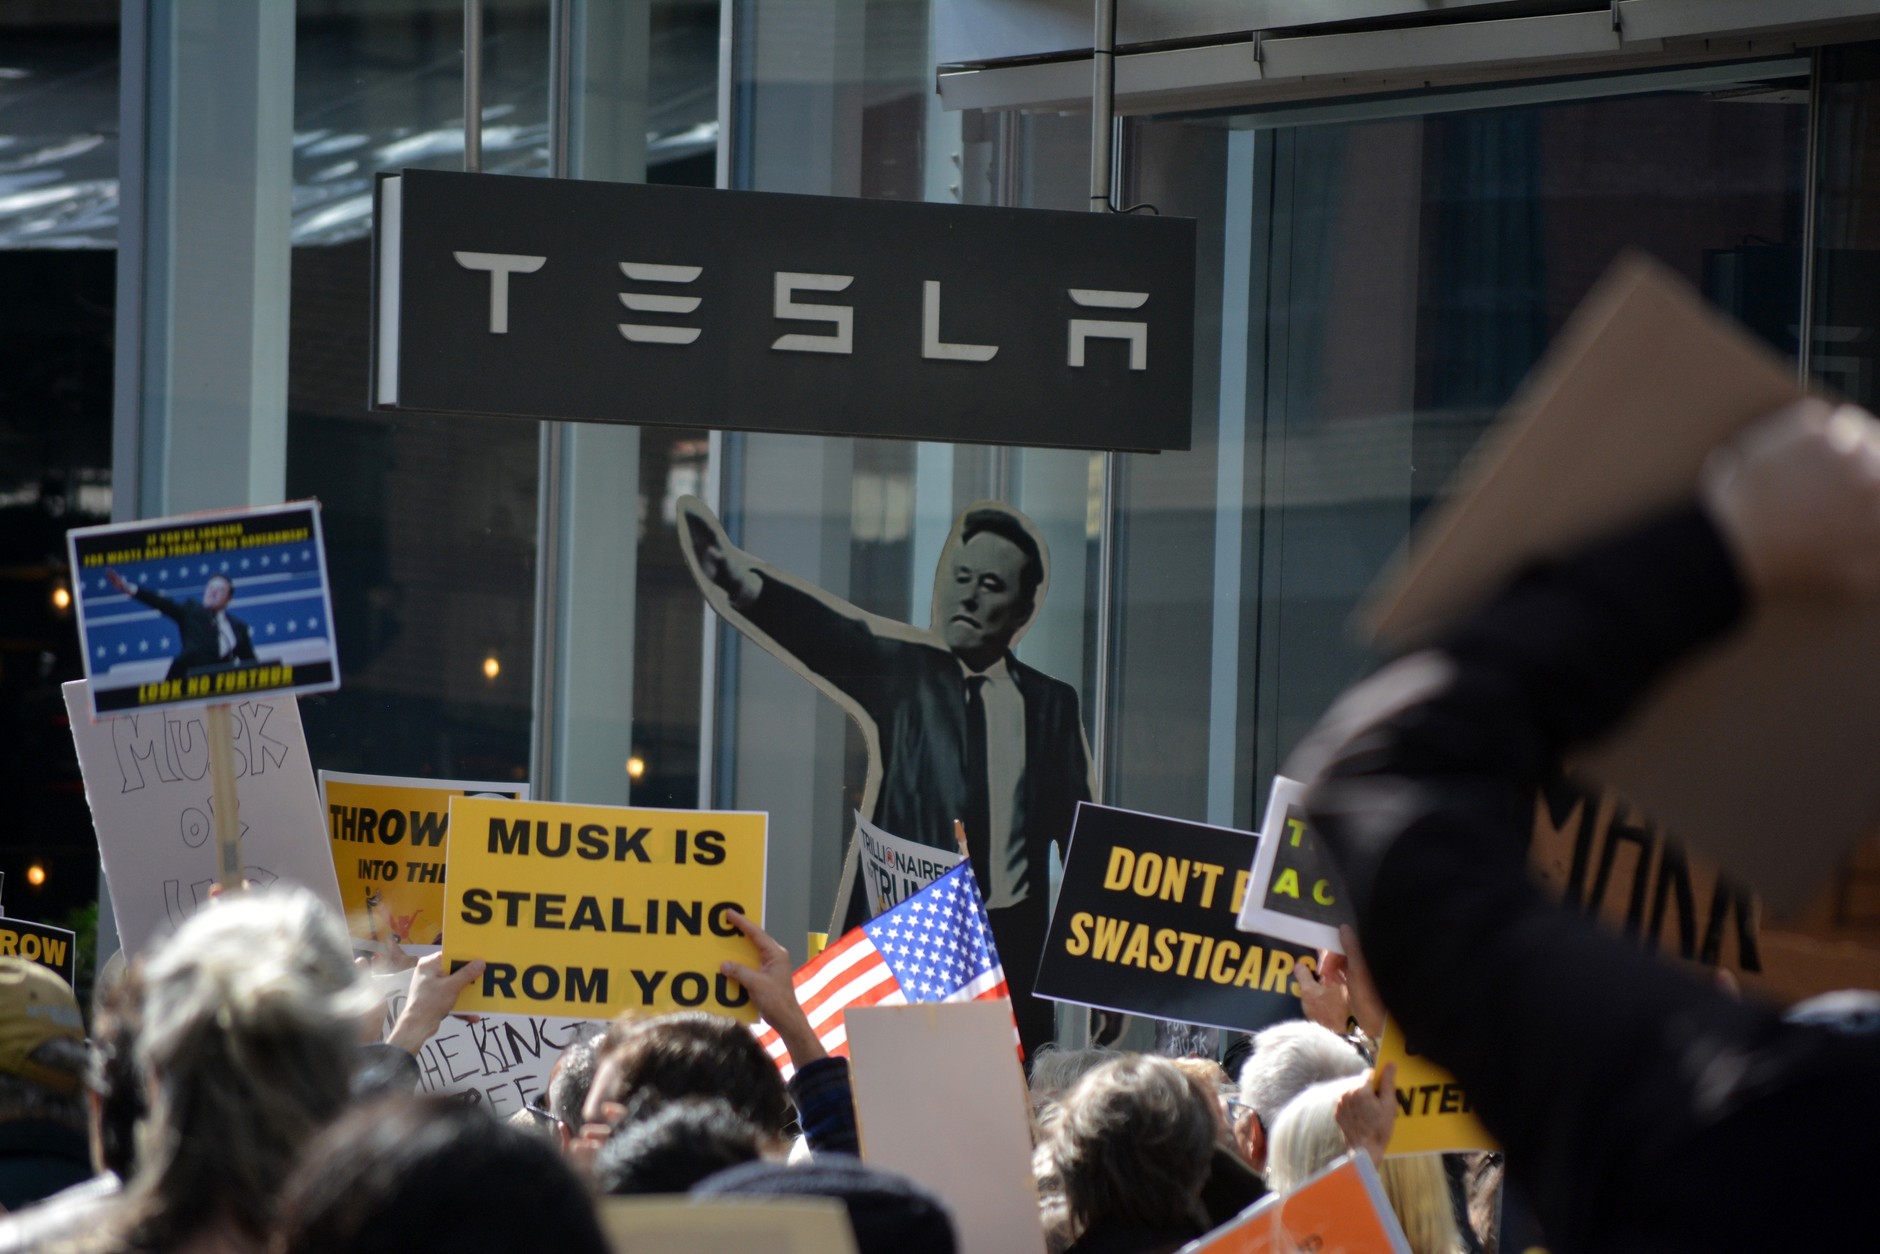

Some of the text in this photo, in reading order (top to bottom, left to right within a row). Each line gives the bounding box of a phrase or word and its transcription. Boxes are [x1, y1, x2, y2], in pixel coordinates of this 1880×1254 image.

[453, 250, 1150, 371] TESLA
[107, 549, 142, 563] WASTE
[145, 546, 165, 559] AND
[240, 528, 308, 548] GOVERNMENT
[139, 681, 185, 703] LOOK
[187, 675, 212, 697] NO
[330, 804, 450, 847] THROW
[487, 817, 727, 866] MUSK IS
[358, 859, 399, 881] INTO
[1104, 846, 1224, 908] DON'T
[461, 888, 746, 937] STEALING
[1066, 911, 1317, 998] SWASTICARS
[630, 969, 751, 1008] YOU
[1396, 1082, 1476, 1117] NTE
